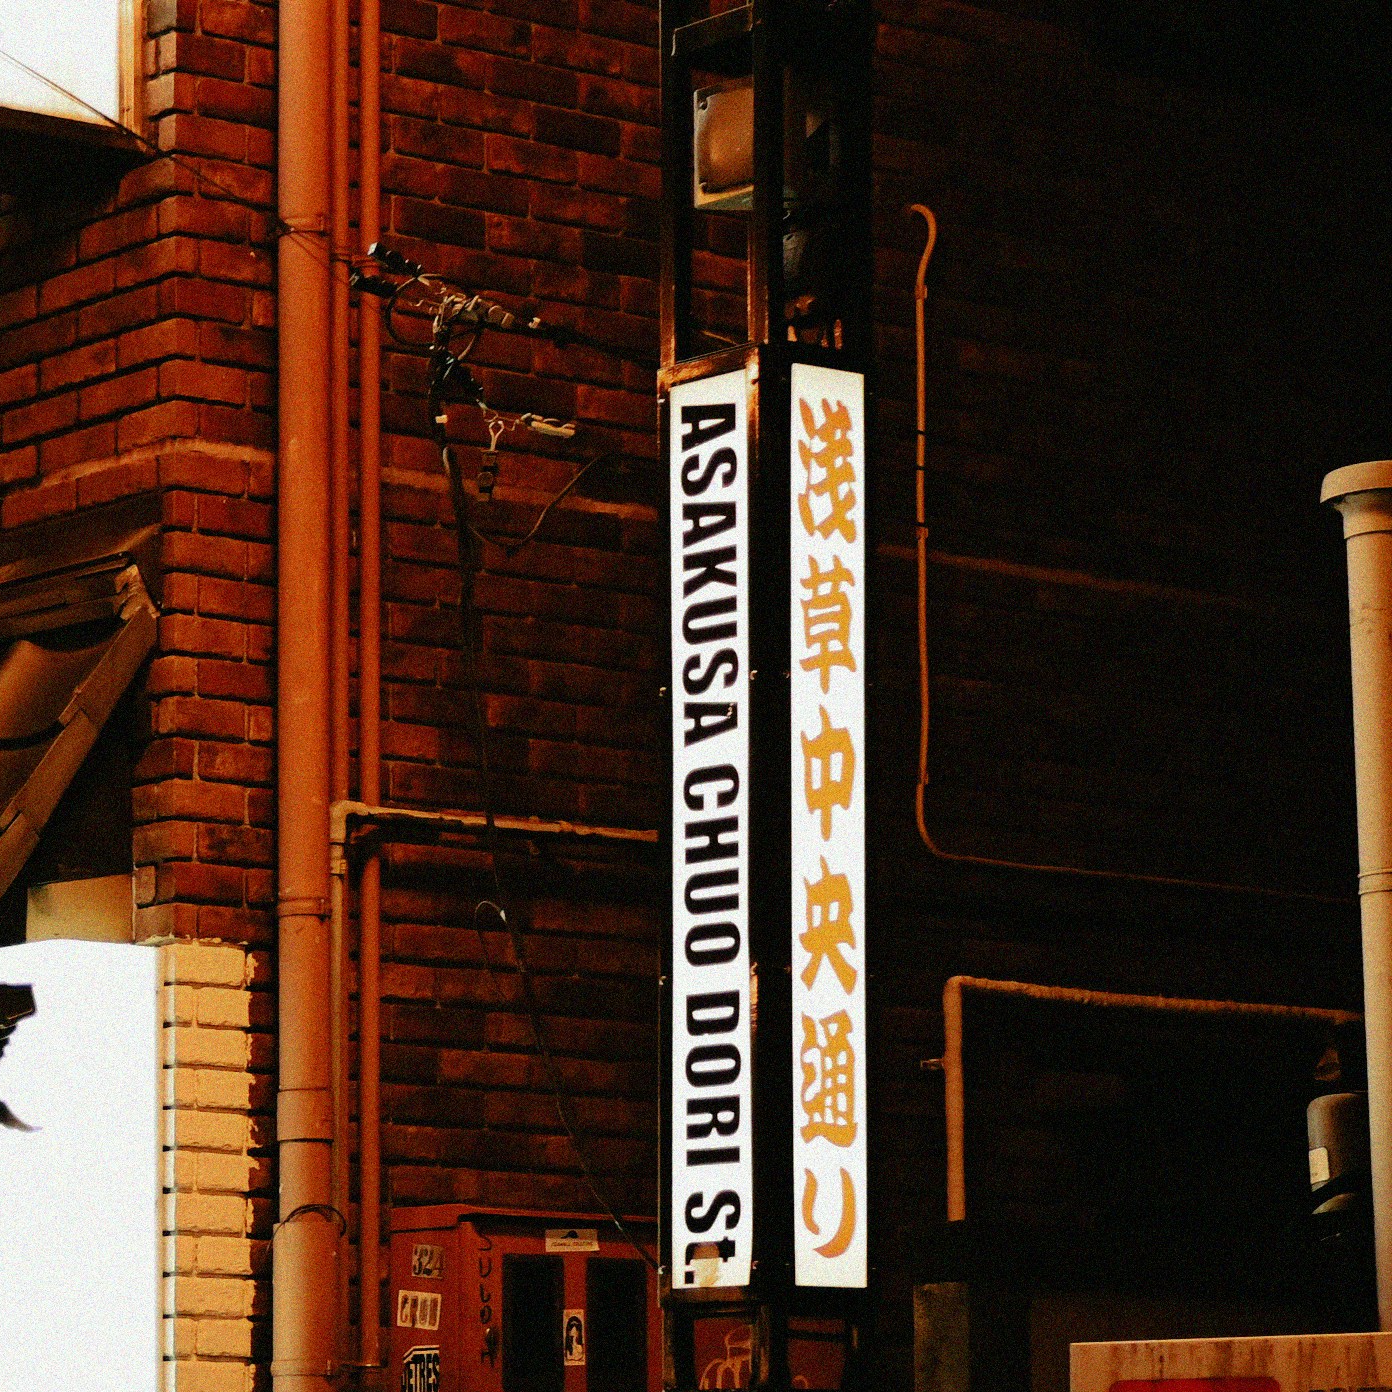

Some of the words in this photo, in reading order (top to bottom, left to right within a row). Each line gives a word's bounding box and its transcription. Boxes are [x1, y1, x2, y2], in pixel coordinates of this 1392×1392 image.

[679, 403, 738, 745] ASAKUSA
[682, 764, 740, 966] CHUO
[798, 397, 860, 1260] 浅草中央通り
[685, 993, 742, 1168] DORI
